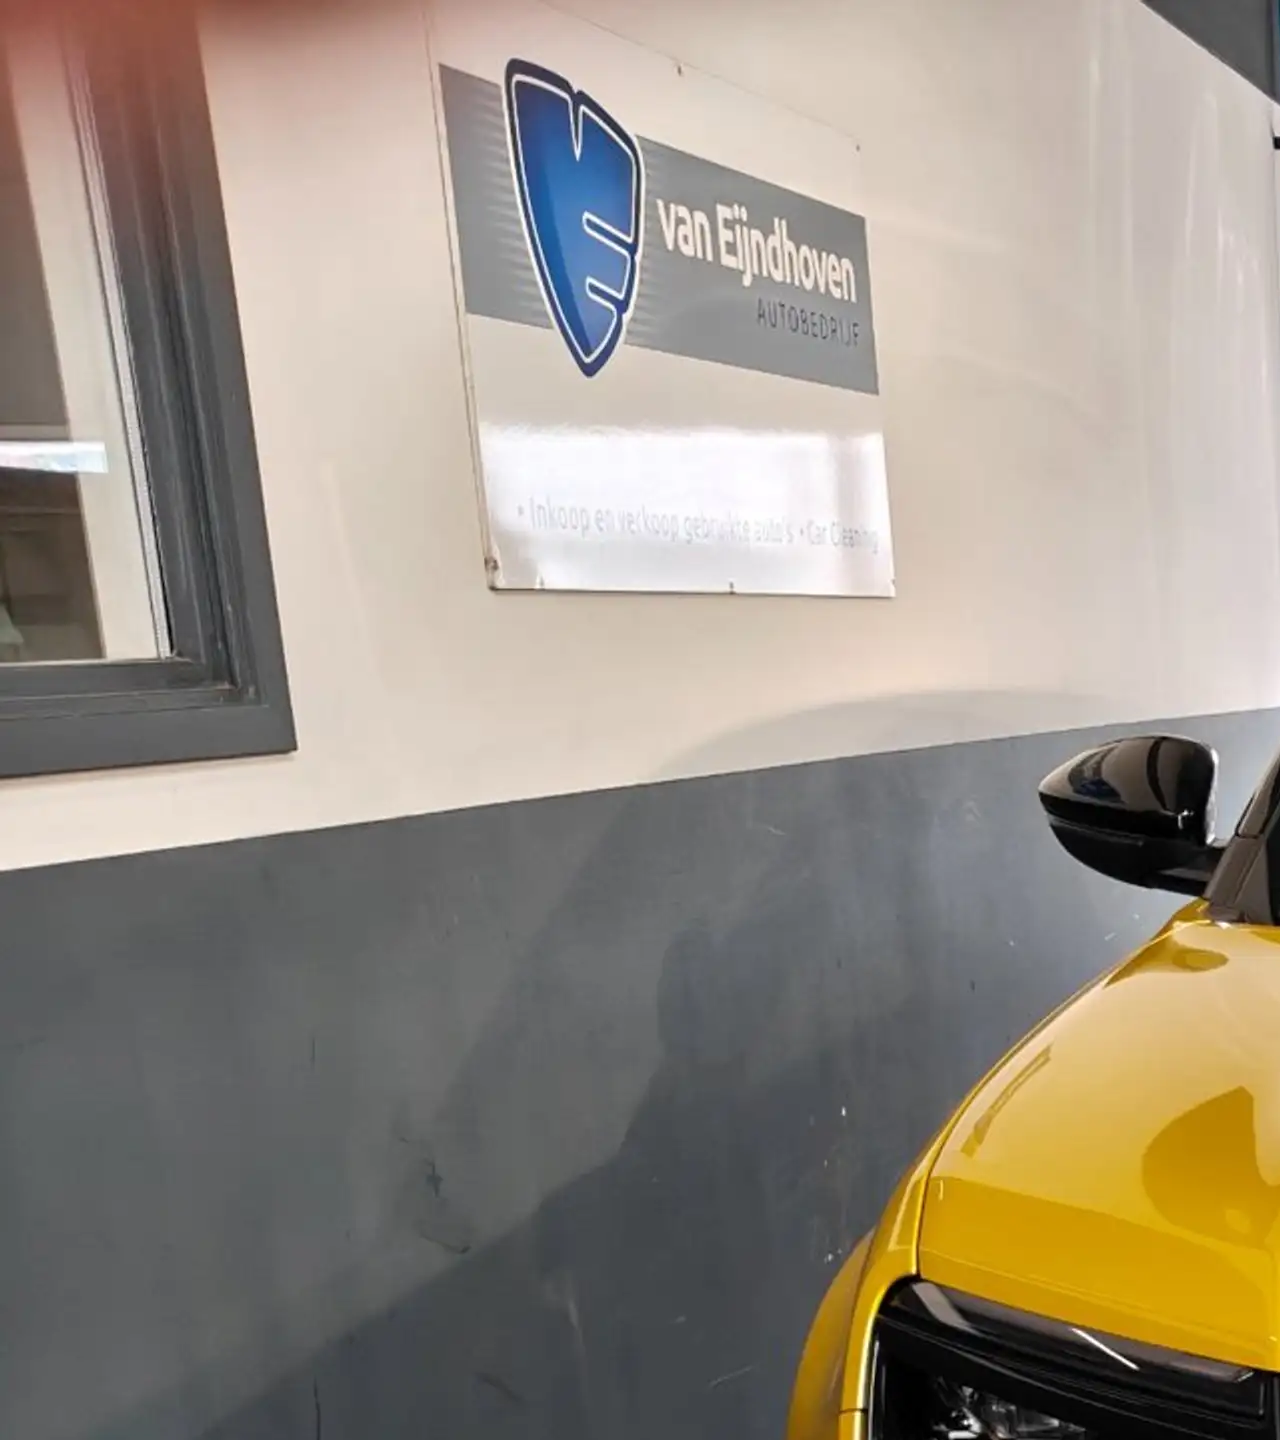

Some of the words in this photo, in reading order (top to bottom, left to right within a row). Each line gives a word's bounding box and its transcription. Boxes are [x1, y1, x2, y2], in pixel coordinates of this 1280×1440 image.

[656, 199, 713, 262] van
[716, 203, 858, 303] Eijndhoven
[757, 298, 860, 347] AUTOBEDRIJF
[529, 495, 590, 538] Inkoop
[595, 508, 615, 533] en
[619, 503, 679, 542] verkoop
